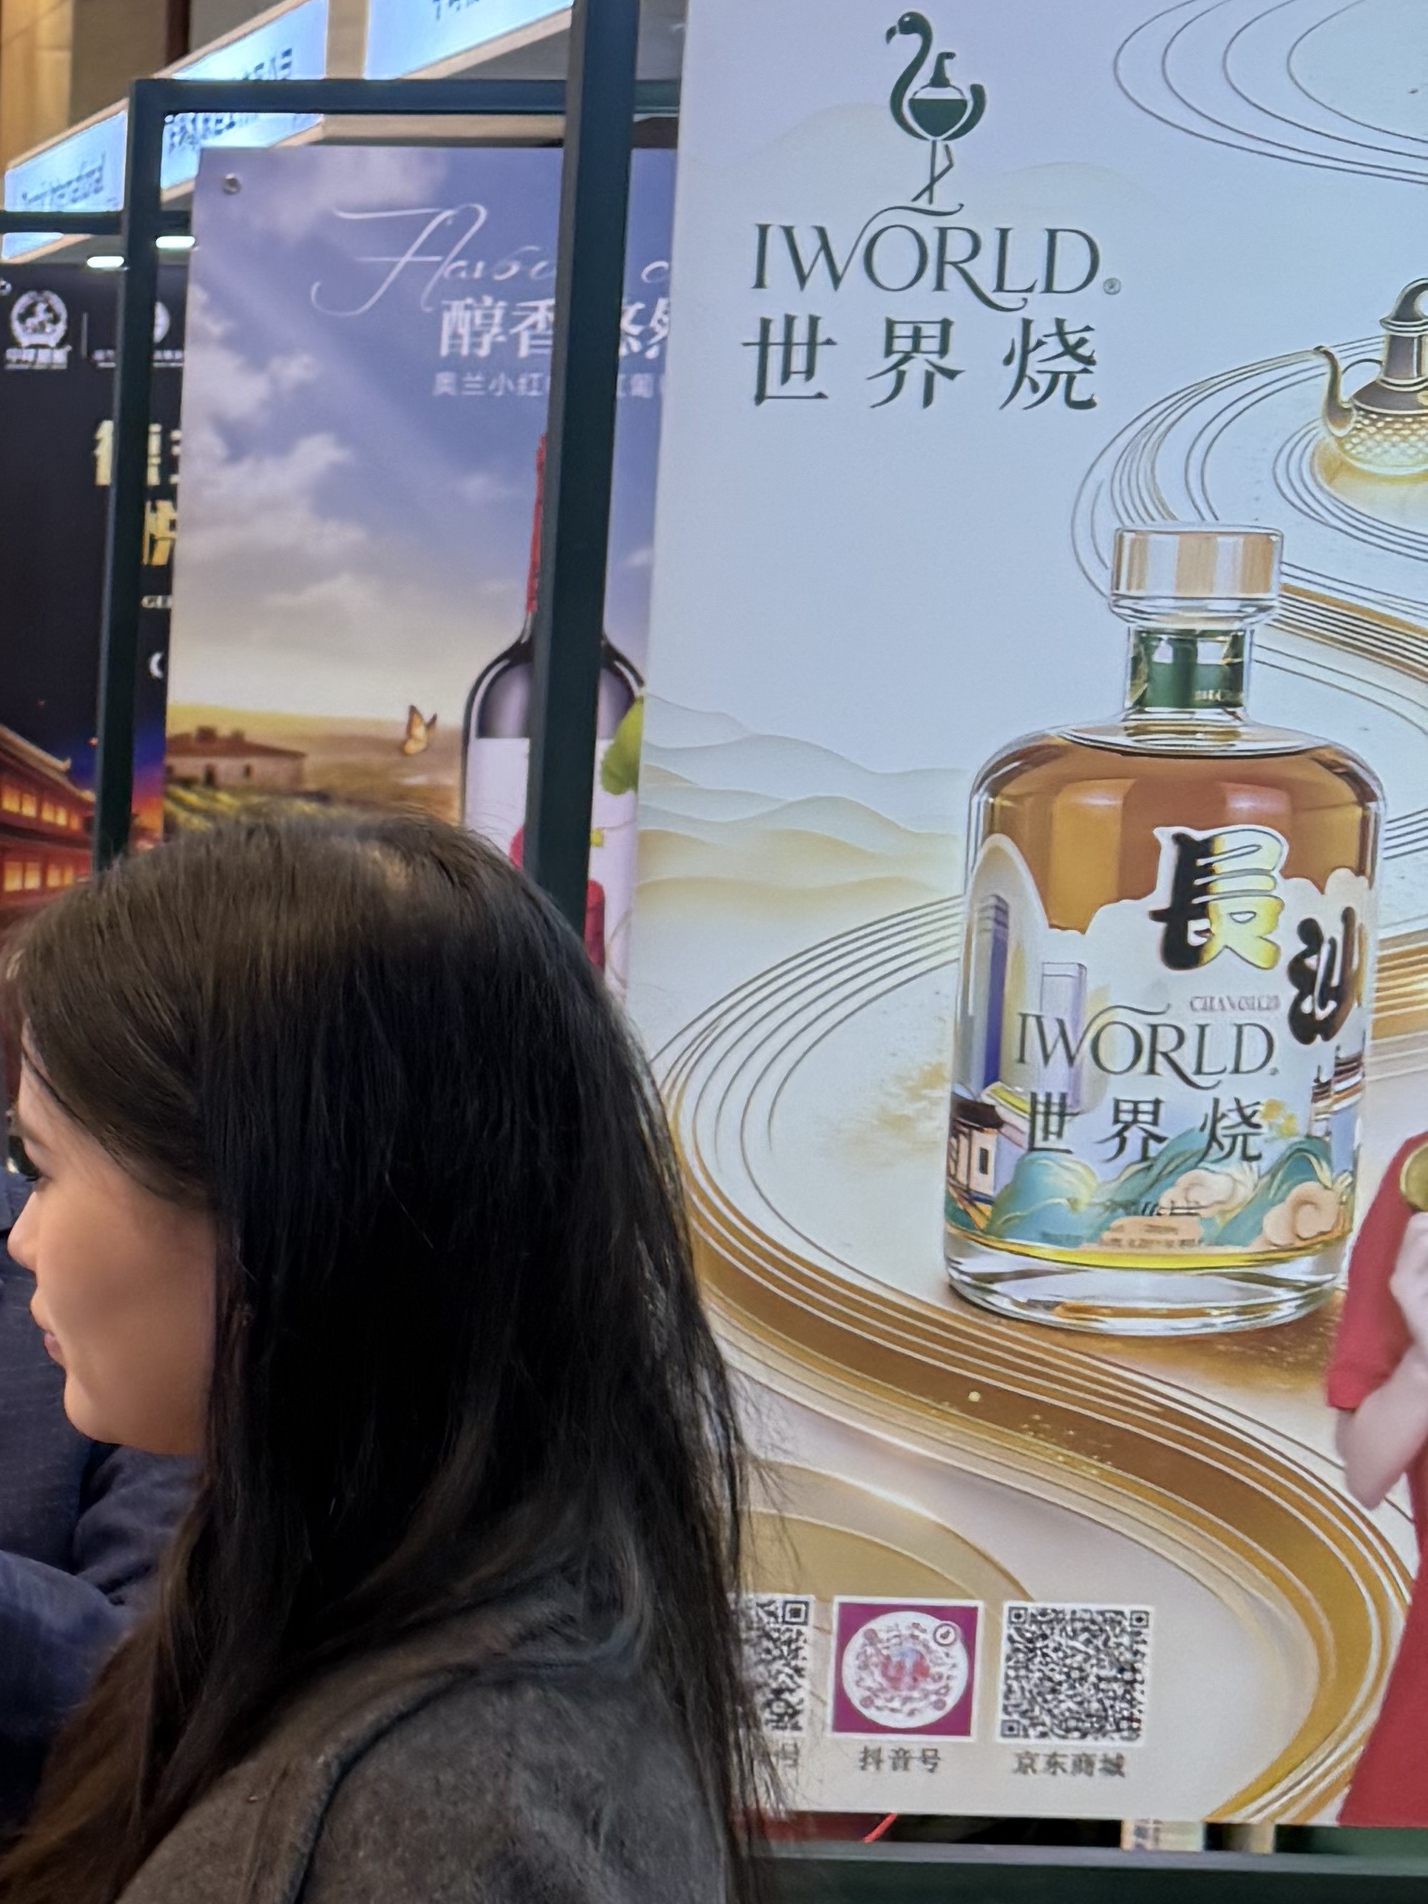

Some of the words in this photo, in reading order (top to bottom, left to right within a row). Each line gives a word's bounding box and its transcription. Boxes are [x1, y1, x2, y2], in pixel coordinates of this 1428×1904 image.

[741, 313, 1099, 411] 世界烧
[1026, 1094, 1265, 1164] 世界烧
[858, 1746, 942, 1774] 抖音号
[1012, 1751, 1127, 1778] 京东商城
